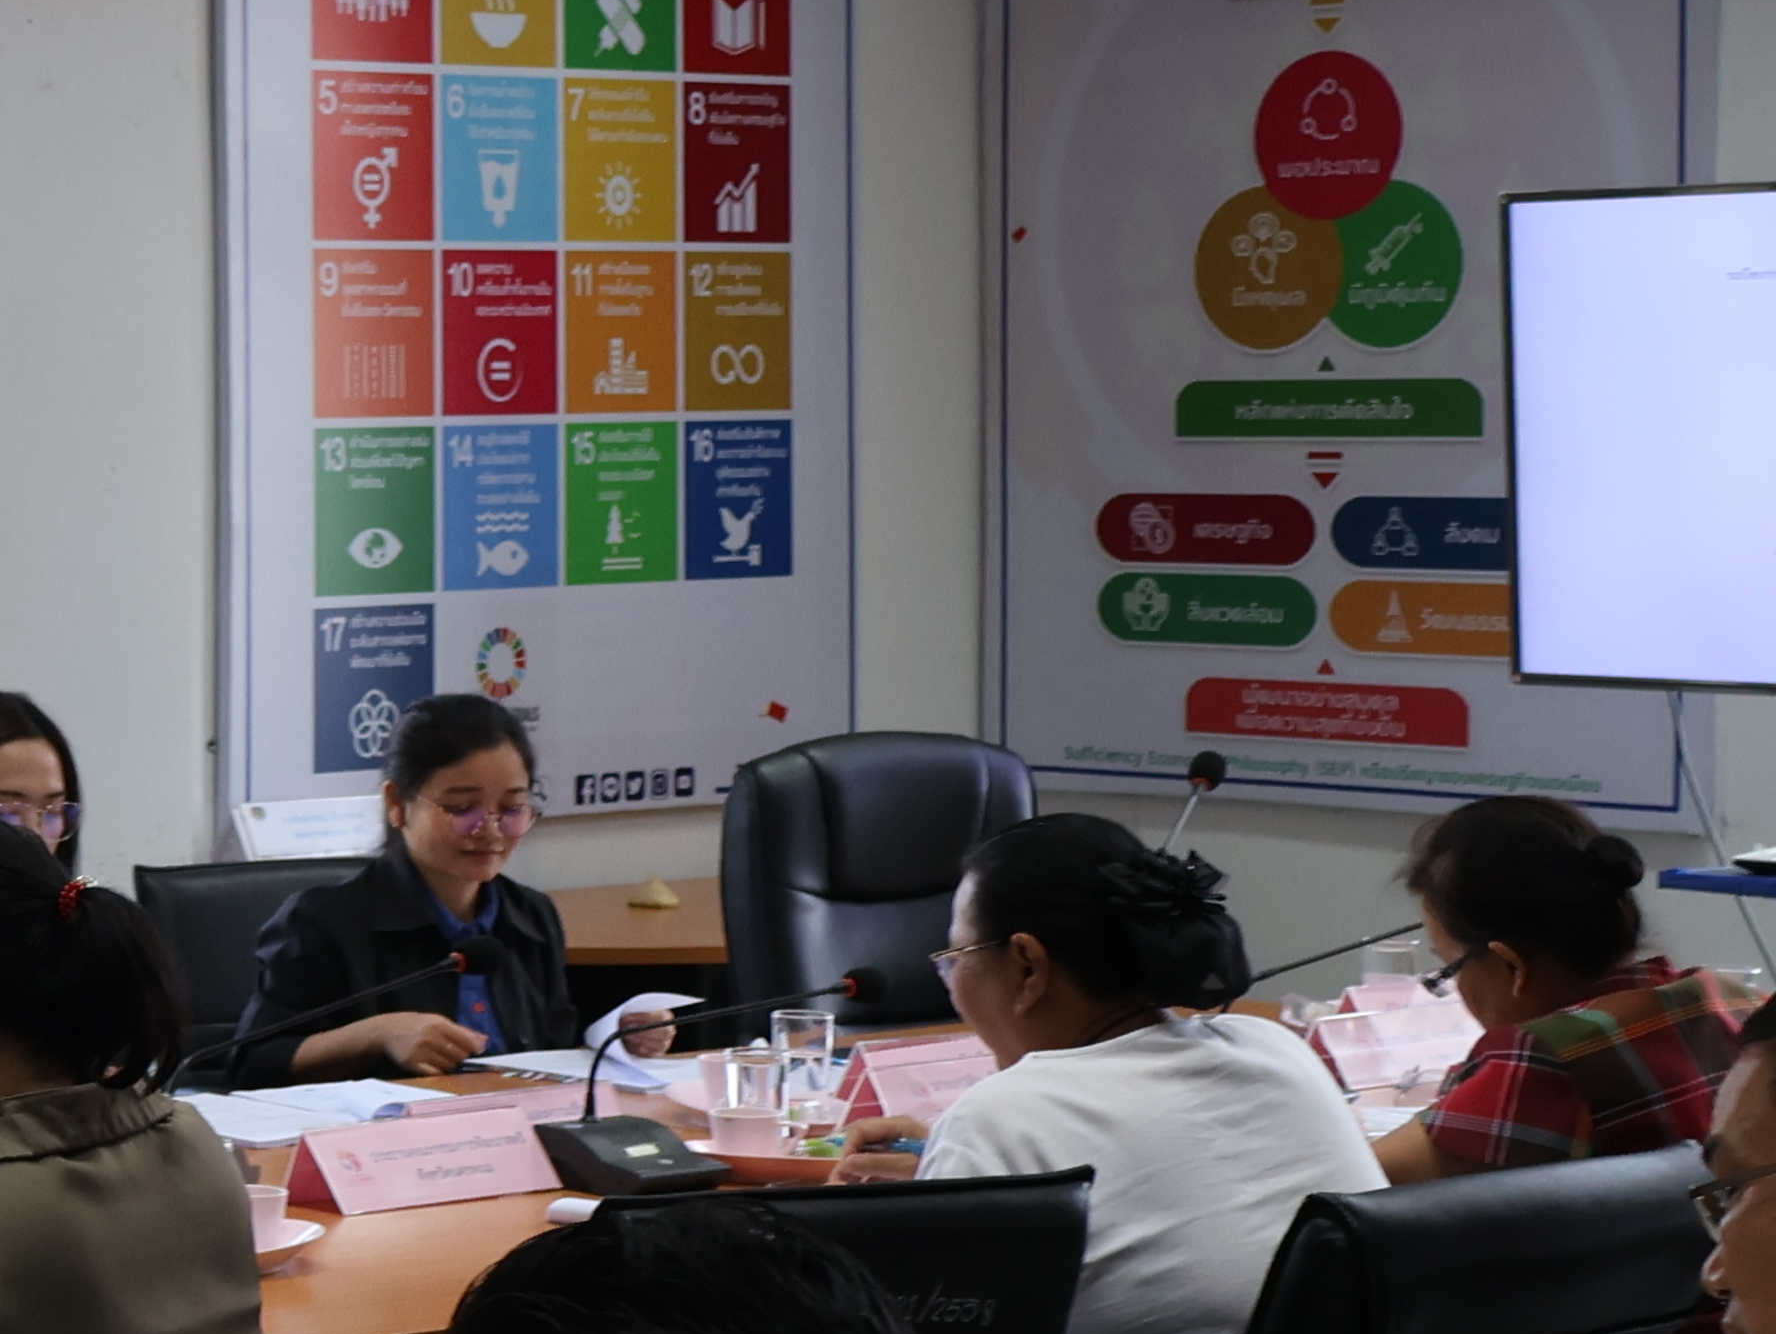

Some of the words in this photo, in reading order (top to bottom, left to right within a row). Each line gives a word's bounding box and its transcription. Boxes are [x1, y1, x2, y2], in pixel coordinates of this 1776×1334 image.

[317, 79, 337, 115] 5
[445, 83, 466, 119] 6
[568, 87, 586, 123] 7
[687, 91, 706, 126] 8
[319, 261, 339, 297] 9
[447, 261, 474, 297] 10
[571, 262, 594, 297] 11
[690, 262, 713, 297] 12
[319, 436, 346, 472] 13
[448, 434, 474, 469] 14
[571, 431, 597, 465] 15
[690, 429, 713, 463] 16
[319, 616, 346, 653] 17
